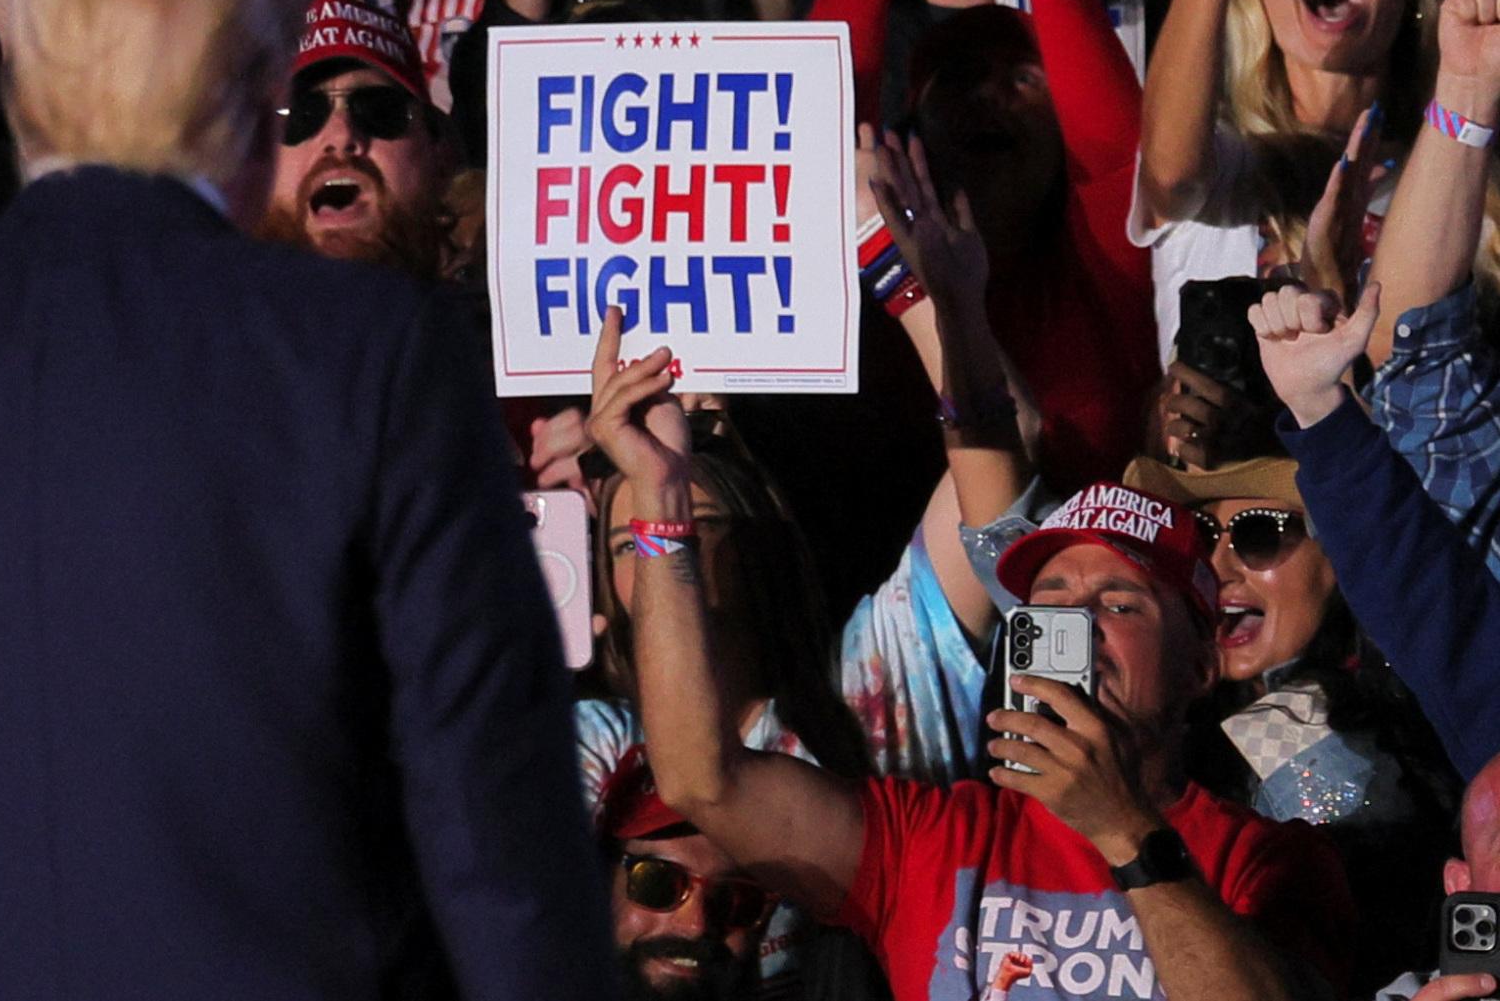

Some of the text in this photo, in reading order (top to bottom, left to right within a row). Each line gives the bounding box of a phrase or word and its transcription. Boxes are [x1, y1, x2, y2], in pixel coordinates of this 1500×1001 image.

[538, 73, 794, 153] FIGHT!
[535, 164, 792, 245] FIGHT!
[535, 256, 795, 336] FIGHT!
[1081, 485, 1174, 529] AMERICA
[1092, 508, 1160, 544] AGAIN
[980, 897, 1144, 951] TRUM
[954, 927, 1168, 1000] STRON
